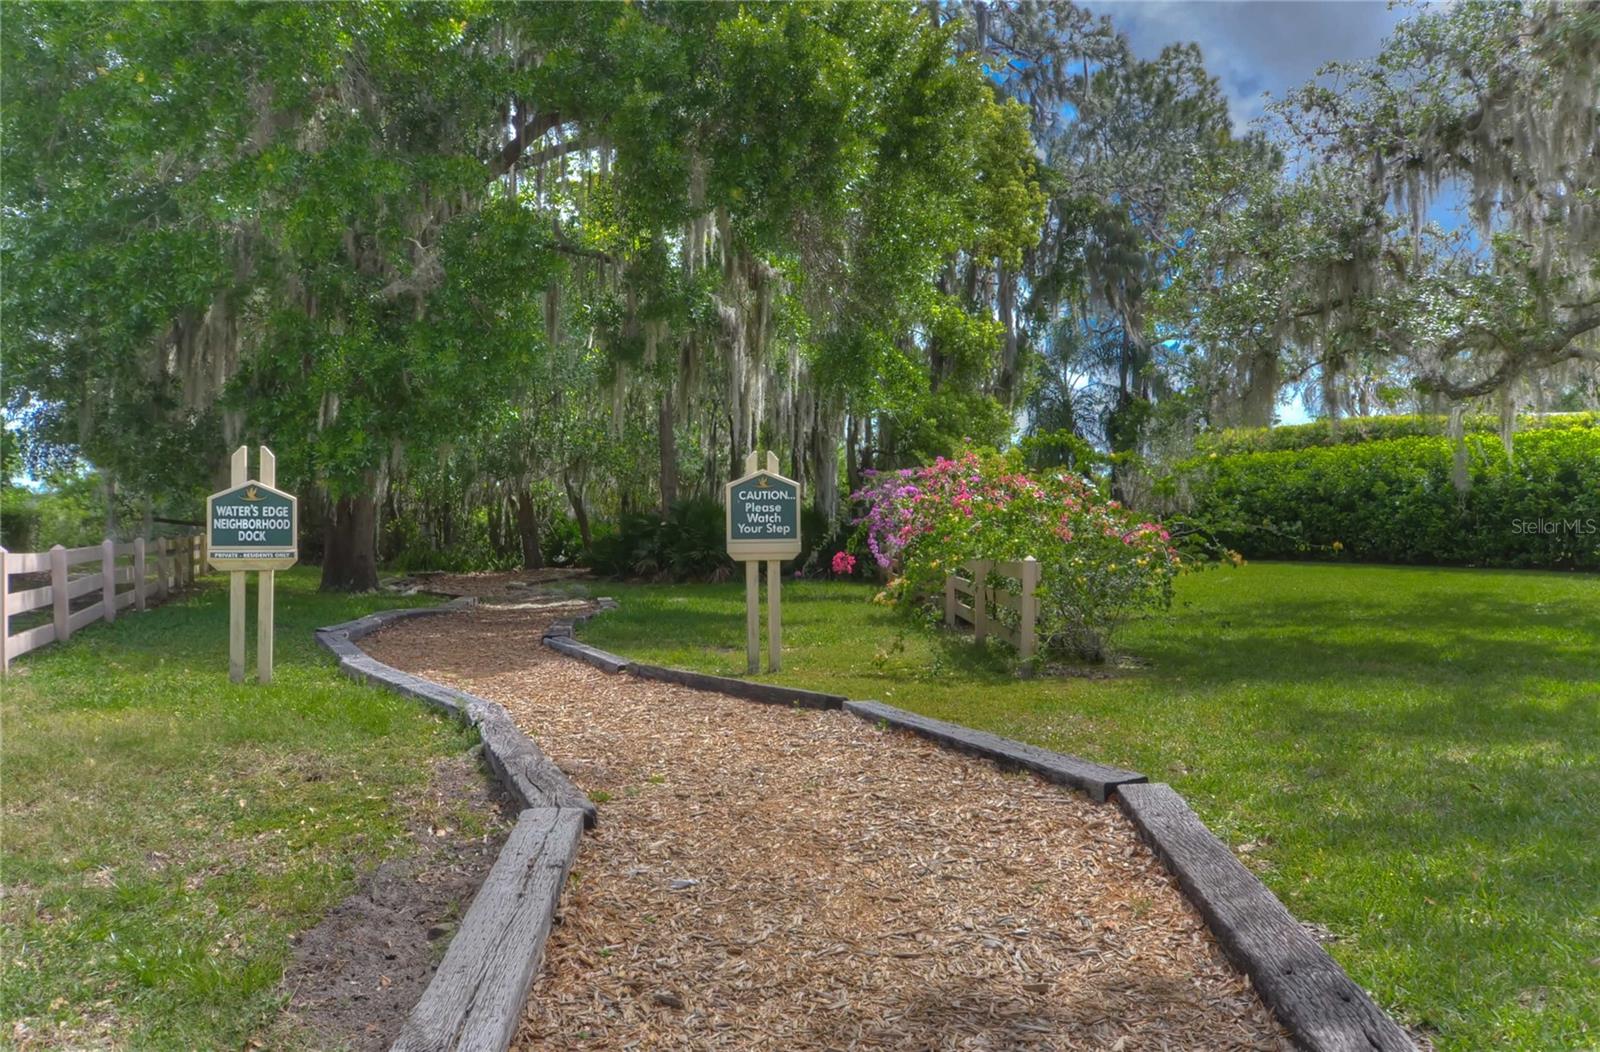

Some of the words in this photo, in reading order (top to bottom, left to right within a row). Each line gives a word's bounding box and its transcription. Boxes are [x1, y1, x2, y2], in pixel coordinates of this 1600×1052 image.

[216, 504, 259, 517] WATER'S
[262, 506, 289, 517] EDGE
[745, 502, 782, 512] Please
[213, 518, 291, 530] NEIGHBORHOOD
[746, 513, 782, 523] Watch
[737, 523, 763, 534] Your
[766, 523, 791, 535] Step
[238, 530, 267, 542] DOCK
